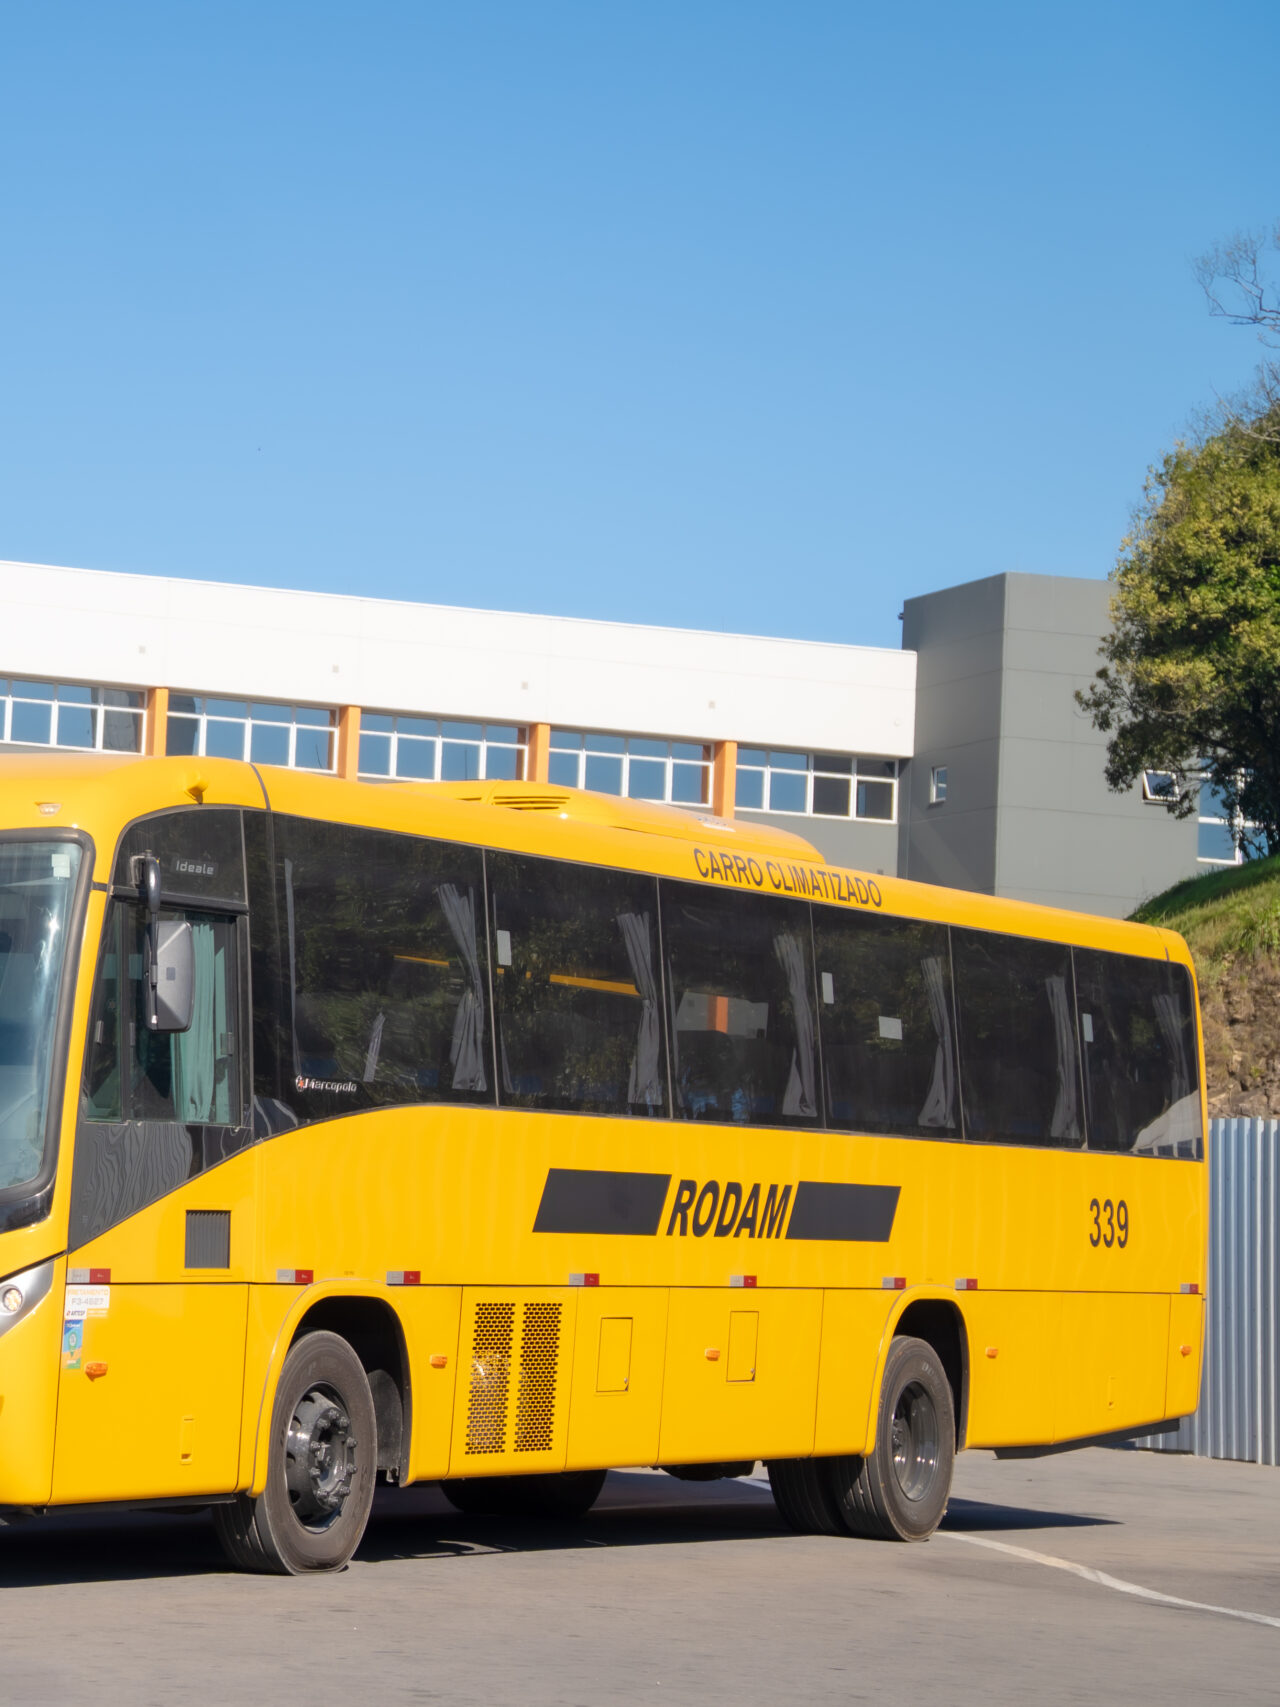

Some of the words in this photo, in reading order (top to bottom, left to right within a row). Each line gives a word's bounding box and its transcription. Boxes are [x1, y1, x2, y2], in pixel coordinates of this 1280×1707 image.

[176, 860, 214, 875] Ideale
[693, 848, 764, 887] CARRO
[766, 861, 882, 907] CLIMATIZADO
[303, 1078, 357, 1093] Marcopolo
[666, 1179, 793, 1239] RODAM
[1089, 1198, 1130, 1249] 339
